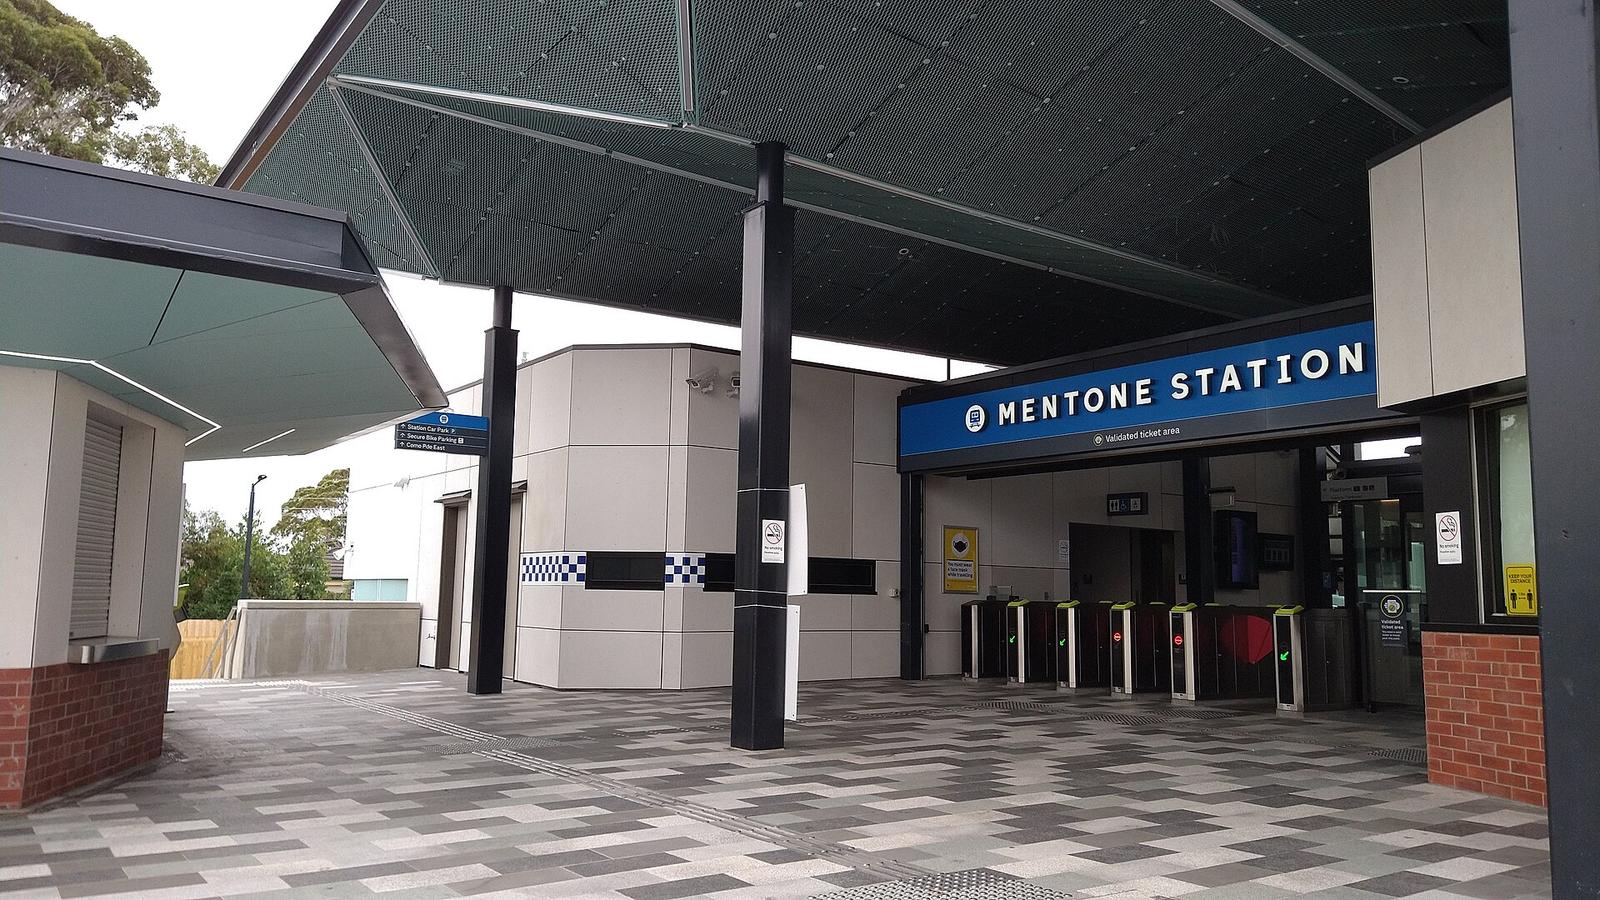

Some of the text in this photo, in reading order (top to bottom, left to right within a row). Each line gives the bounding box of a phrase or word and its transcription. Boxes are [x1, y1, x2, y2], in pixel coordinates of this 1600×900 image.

[999, 341, 1364, 426] MENTONE STATION
[407, 423, 426, 432] Station
[437, 436, 457, 444] Parking
[1105, 427, 1180, 442] Validated ticket area
